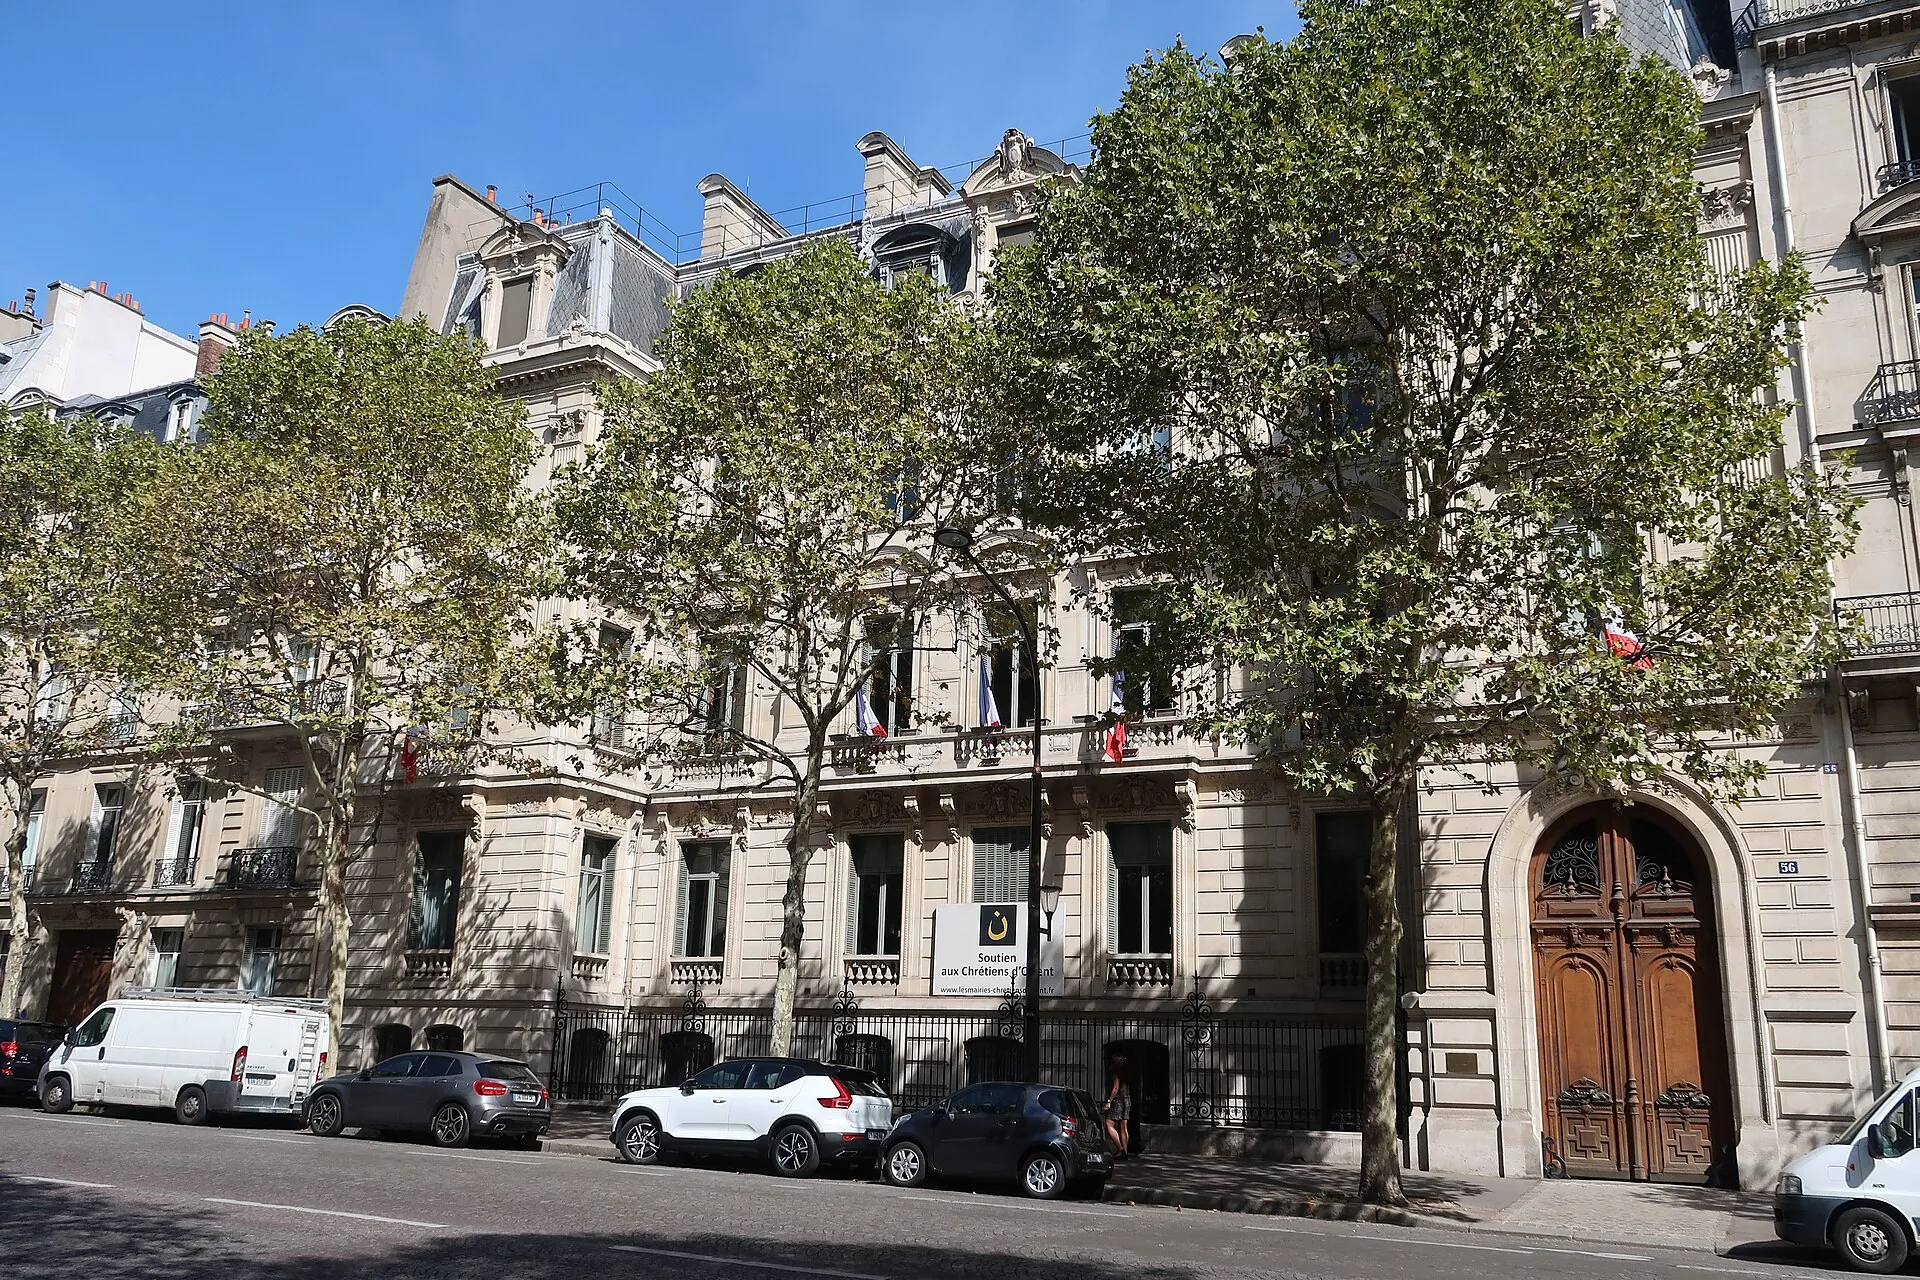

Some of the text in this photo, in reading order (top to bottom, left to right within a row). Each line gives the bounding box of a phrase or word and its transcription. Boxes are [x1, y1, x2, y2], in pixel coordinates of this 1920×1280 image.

[1824, 764, 1837, 772] 56
[1780, 862, 1796, 873] 56
[978, 952, 1017, 963] Soutien
[941, 966, 1054, 977] aux Chrétiens d'Oent
